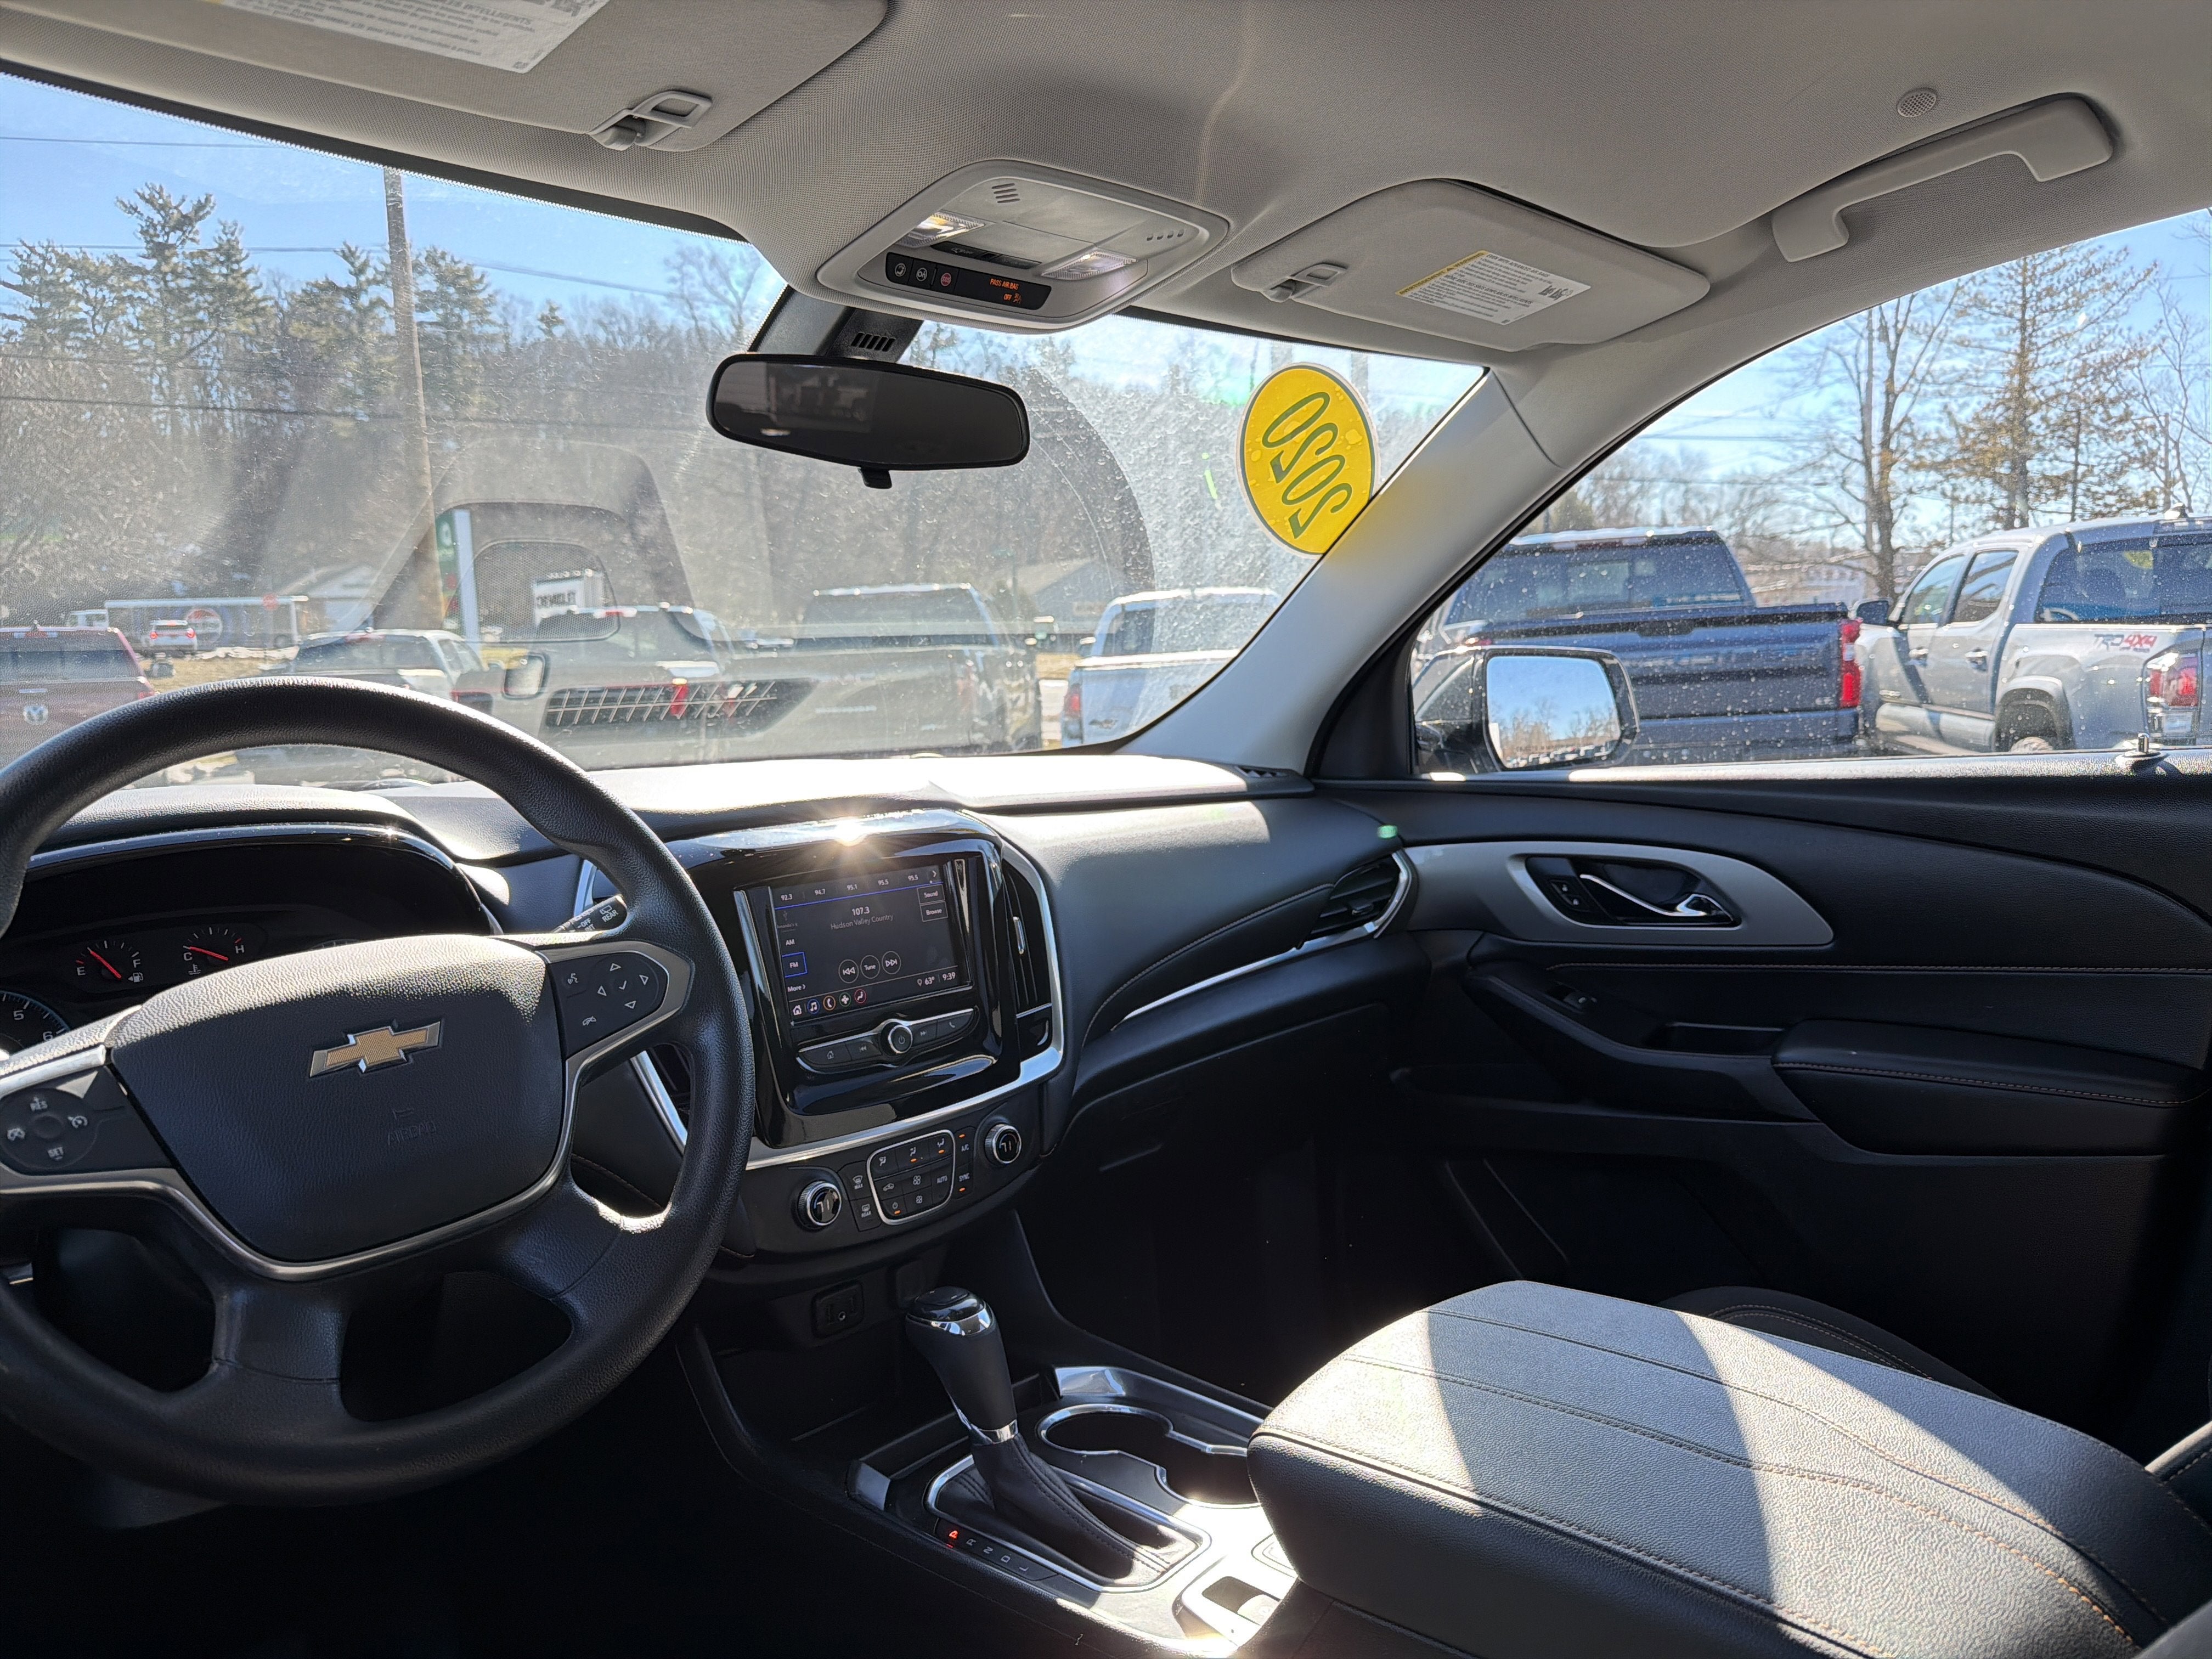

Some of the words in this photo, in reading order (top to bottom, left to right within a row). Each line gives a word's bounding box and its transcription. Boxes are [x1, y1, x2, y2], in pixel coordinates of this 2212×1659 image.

[990, 278, 1002, 286] PASS
[1009, 282, 1019, 290] BAG
[851, 906, 870, 916] 107.3
[601, 909, 619, 923] REAR
[830, 919, 854, 930] Hudson
[854, 916, 871, 926] Valley
[871, 913, 894, 923] Country
[235, 945, 245, 953] H
[183, 952, 193, 961] C
[133, 959, 141, 967] F
[77, 966, 86, 975] E
[942, 972, 956, 981] 9:39
[13, 1009, 24, 1020] 5
[42, 1031, 53, 1041] 6
[961, 1144, 969, 1152] A/C
[1001, 1141, 1012, 1153] 71
[936, 1175, 948, 1184] AUTO
[959, 1172, 970, 1182] SYNC
[983, 1546, 994, 1554] N
[1001, 1555, 1011, 1563] D
